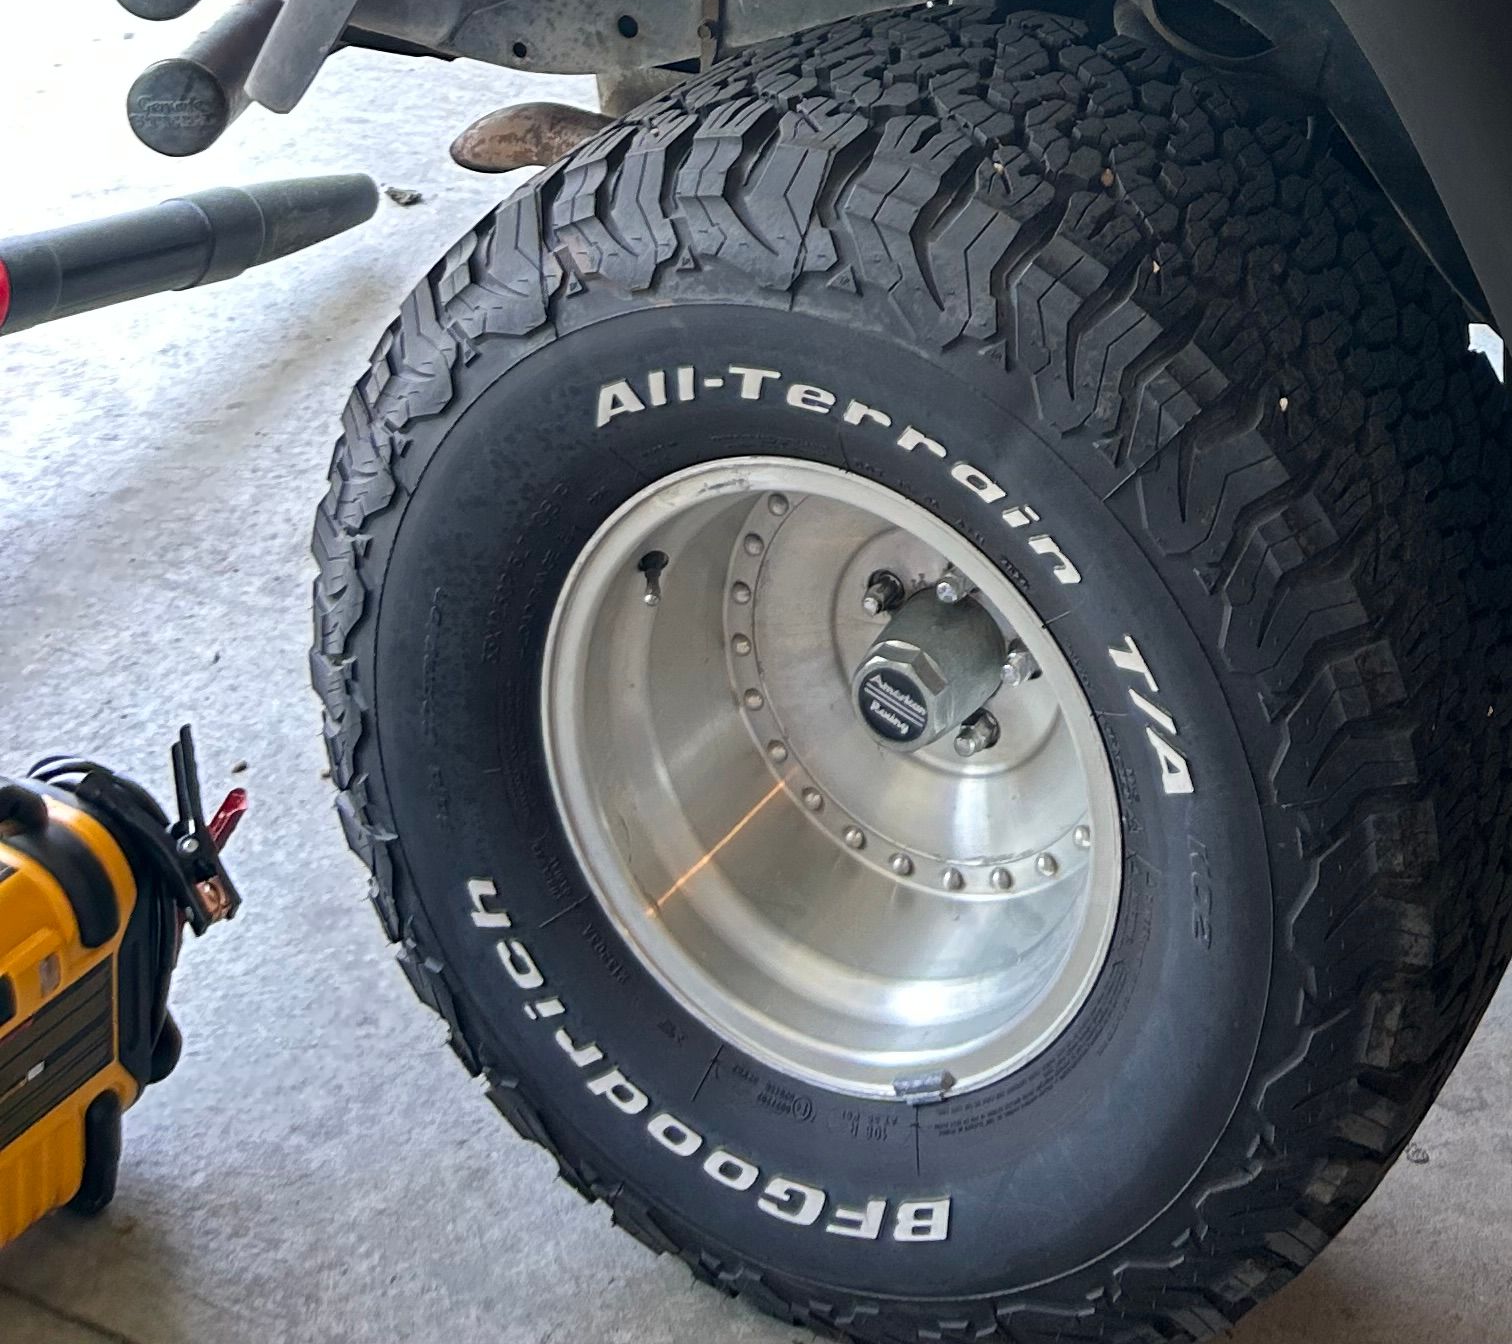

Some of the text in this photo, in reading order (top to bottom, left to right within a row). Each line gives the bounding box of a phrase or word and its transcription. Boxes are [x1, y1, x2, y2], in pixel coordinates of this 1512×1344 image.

[597, 365, 1194, 794] All-Terrain T/A
[468, 876, 951, 1243] BFGoodrich
